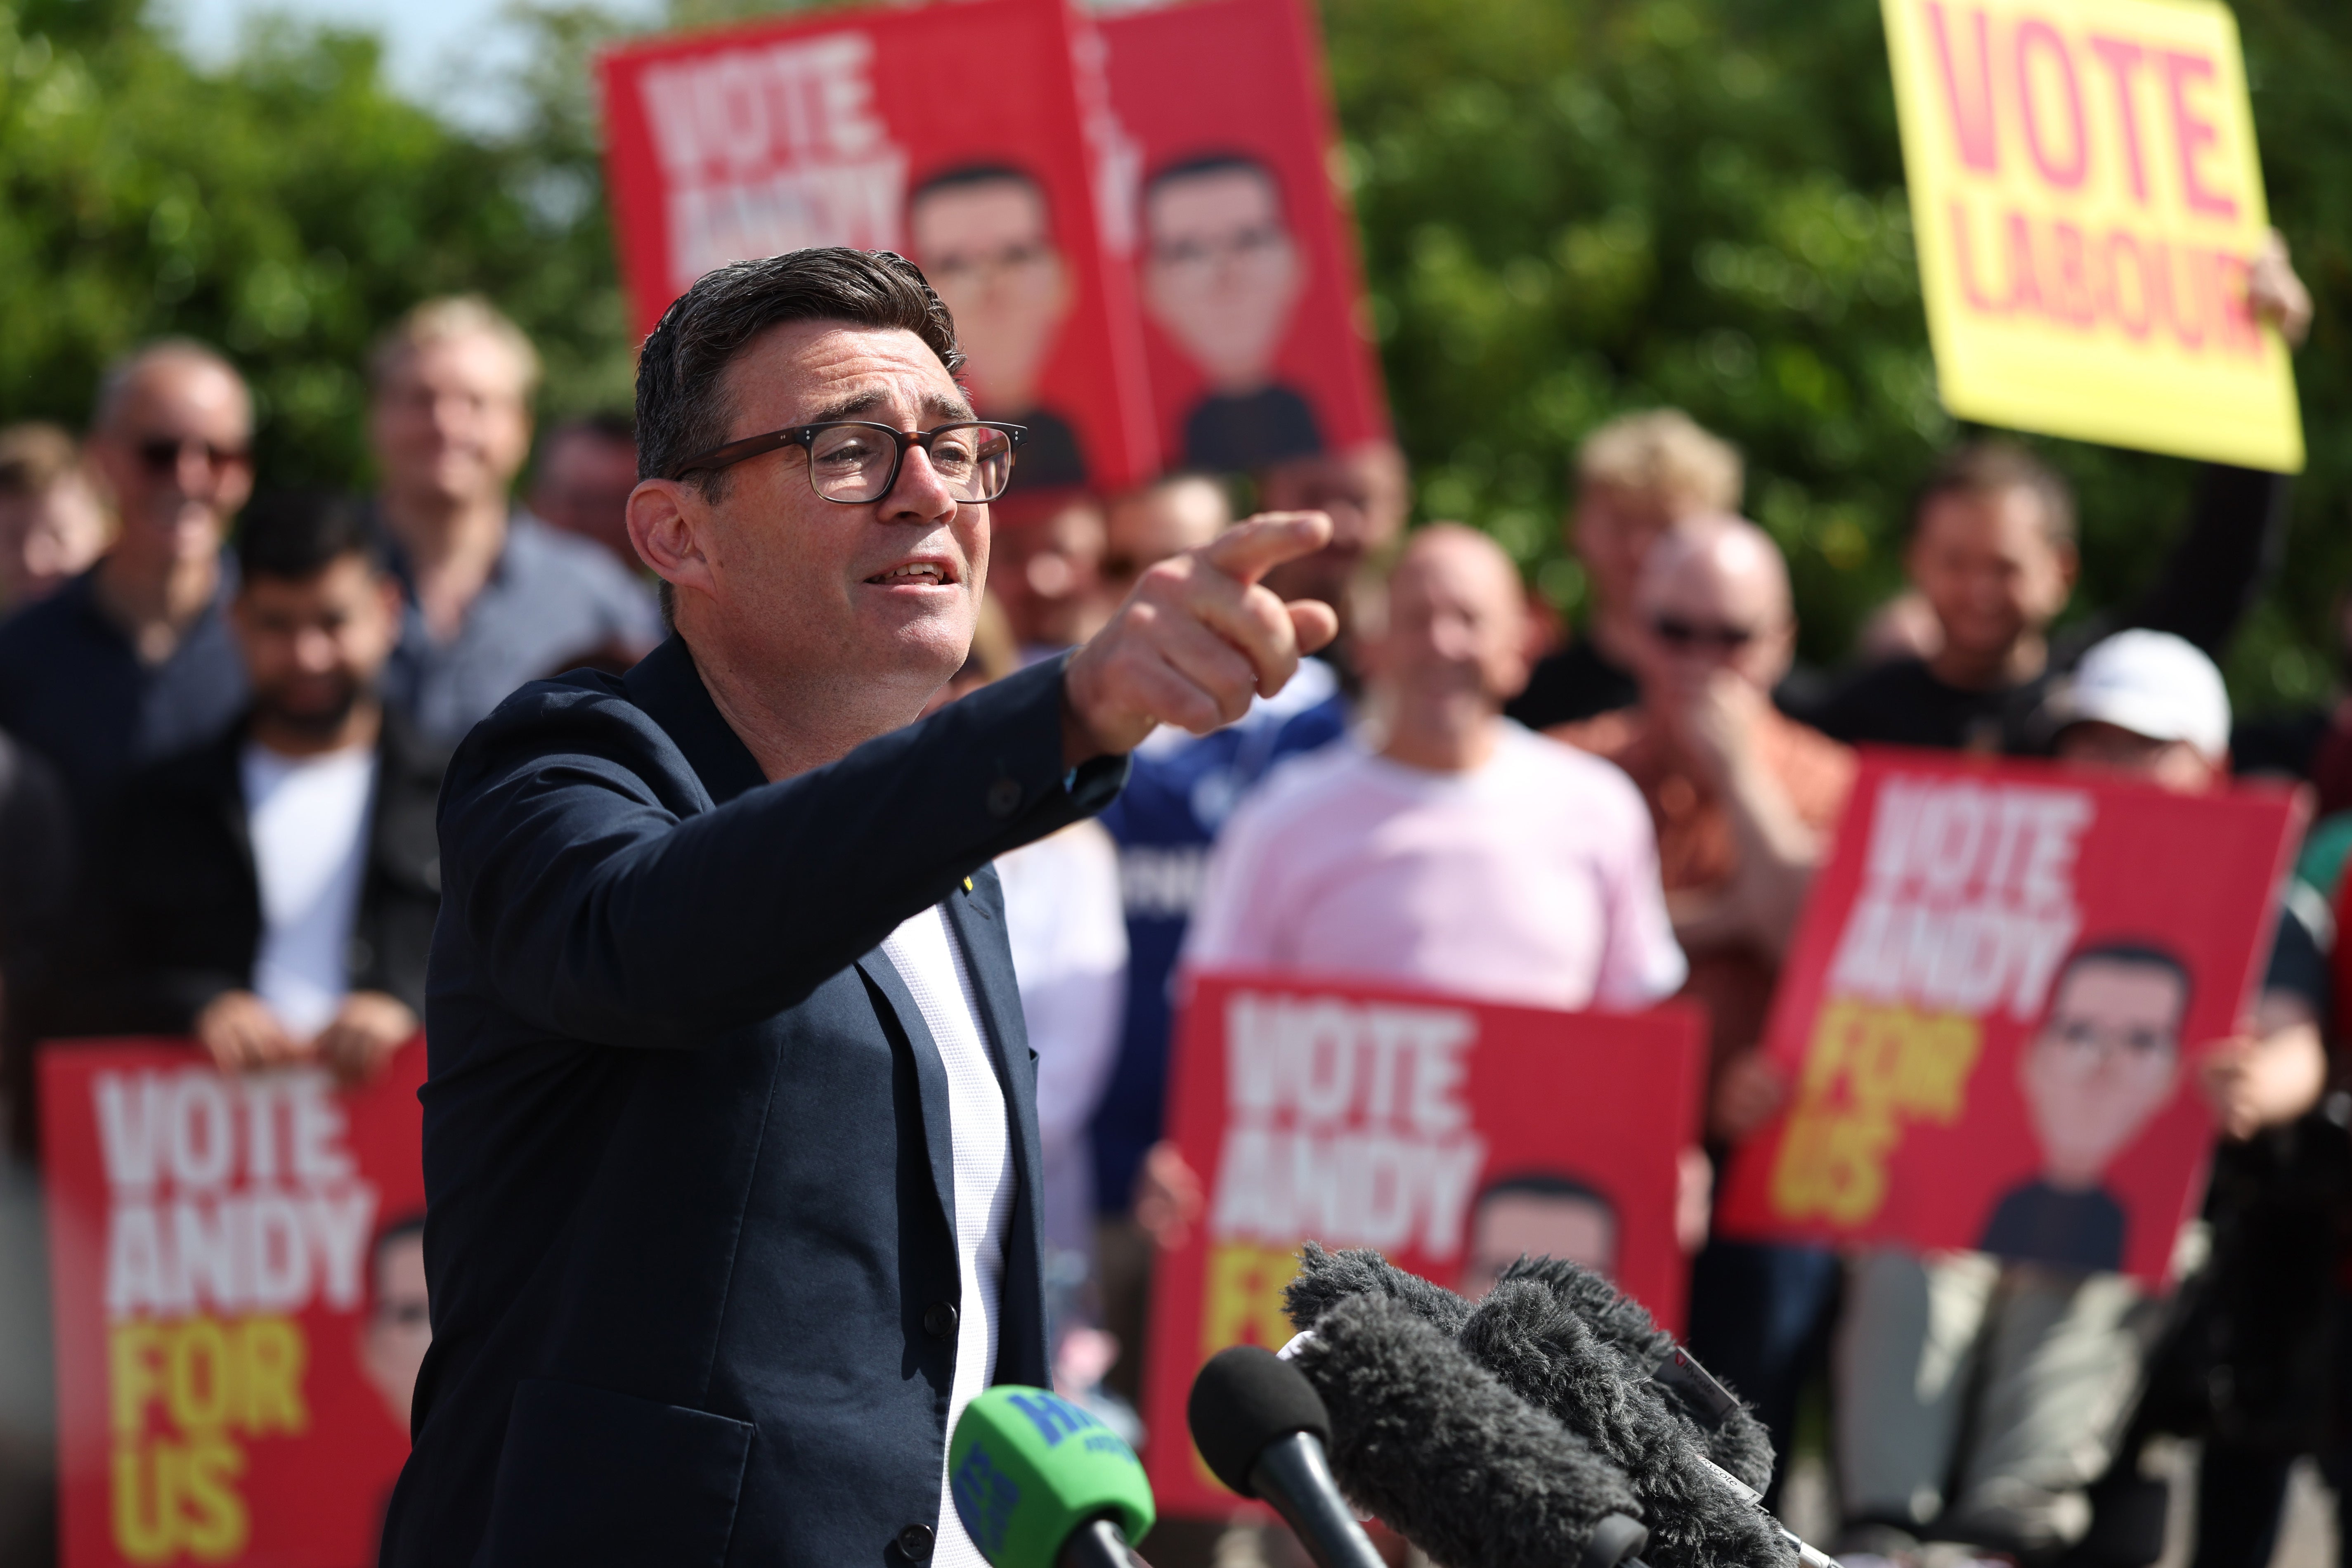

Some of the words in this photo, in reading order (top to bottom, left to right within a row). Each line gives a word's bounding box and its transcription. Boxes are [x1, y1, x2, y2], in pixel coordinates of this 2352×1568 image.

[641, 33, 886, 185] VOTE
[1927, 0, 2238, 224] VOTE
[1870, 777, 2092, 903] VOTE
[1831, 900, 2079, 1019] ANDY
[1225, 993, 1475, 1133] VOTE
[1803, 997, 1982, 1125] FOR
[92, 1067, 358, 1188] VOTE
[1769, 1098, 1898, 1226] US
[106, 1184, 377, 1316] ANDY
[1211, 1125, 1482, 1259] ANDY
[111, 1315, 307, 1436] FOR
[114, 1440, 248, 1562] US
[1702, 1459, 1737, 1486] Rycote
